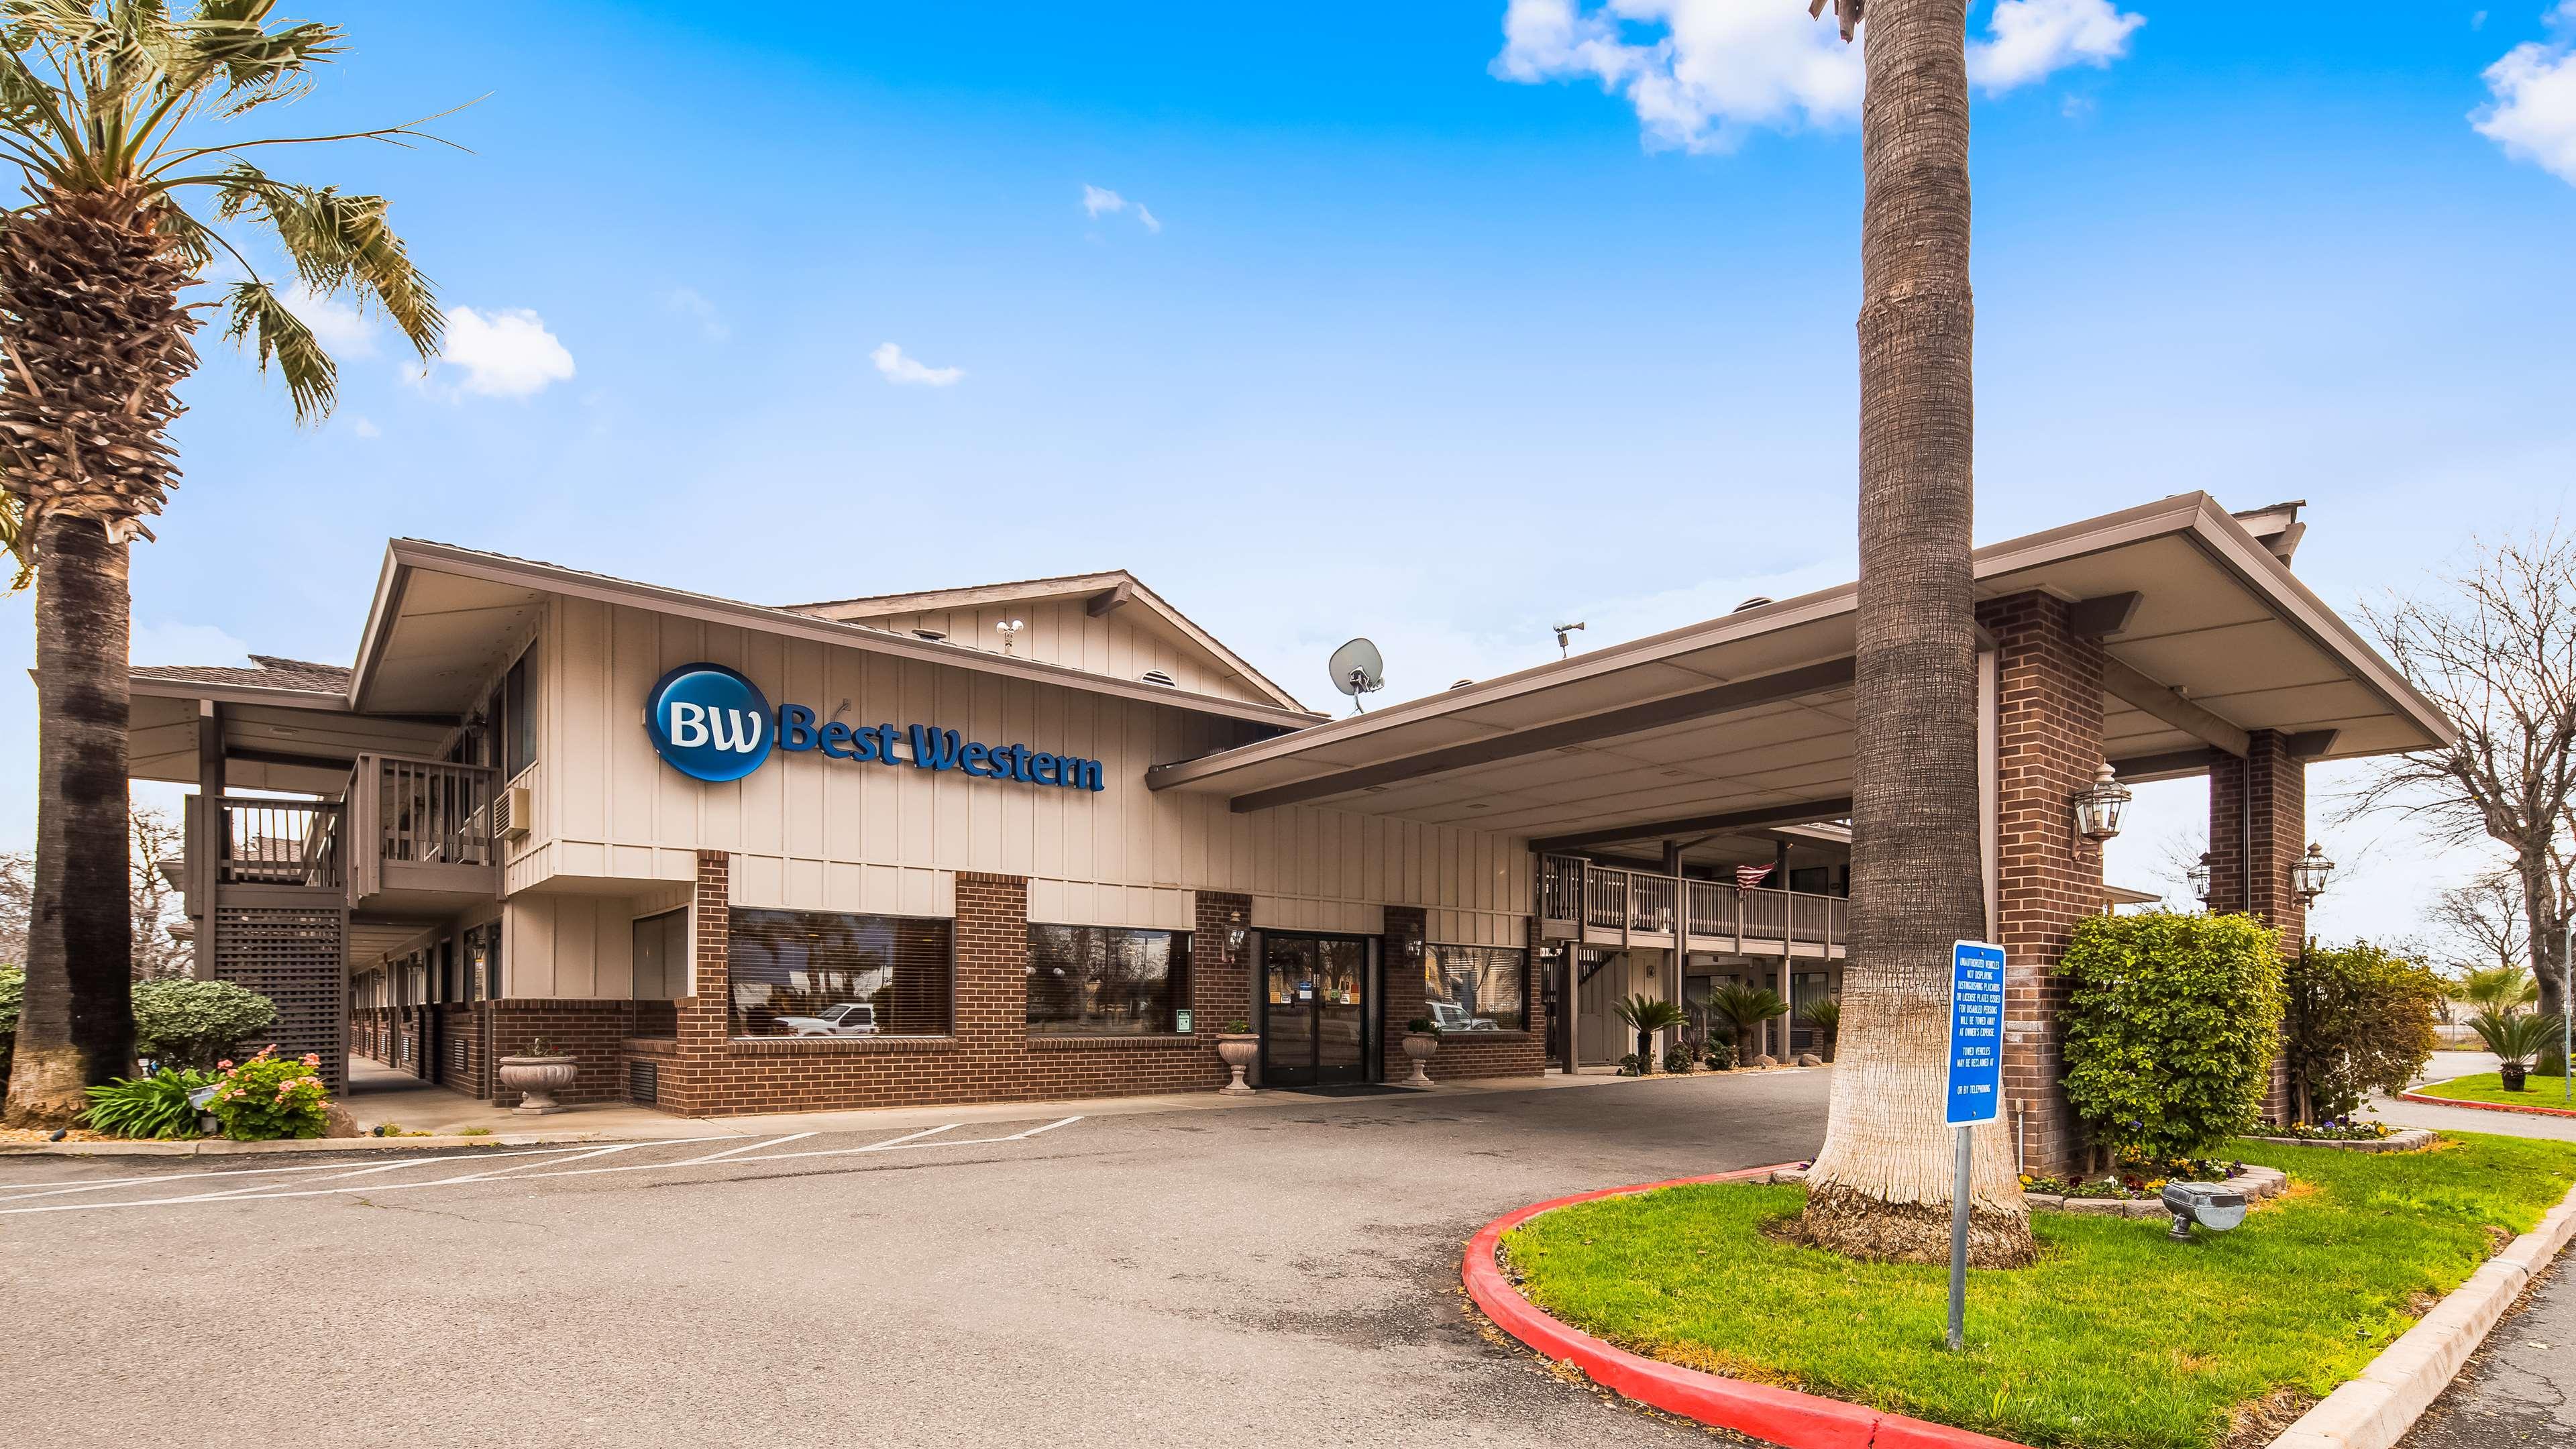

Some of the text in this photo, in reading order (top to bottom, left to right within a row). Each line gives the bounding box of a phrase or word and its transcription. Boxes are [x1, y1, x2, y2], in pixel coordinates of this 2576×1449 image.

[671, 702, 762, 753] BW
[778, 703, 1105, 792] Best Western
[1960, 957, 2000, 970] UNAUTHORIZED VEHICLES
[1975, 971, 1993, 980] DISPLAYING
[1957, 980, 2000, 992] DISTINGUISHING PLACARDS
[1956, 993, 2001, 1003] OR LICENSE PLATES ISSUED
[1966, 1005, 1983, 1014] DISABLED
[1983, 1006, 1998, 1014] PERSONS
[1960, 1016, 1996, 1025] WILL BE TOWED AWAY
[1959, 1028, 1964, 1036] AT
[1980, 1028, 1995, 1036] EXPENSE
[1963, 1047, 1990, 1056] TOWED VEHICLES
[1966, 1059, 1970, 1067] BE
[1971, 1058, 1989, 1067] RECLAIMED
[1989, 1058, 1994, 1067] AT
[1957, 1085, 1963, 1095] OR
[1963, 1085, 1969, 1094] BY
